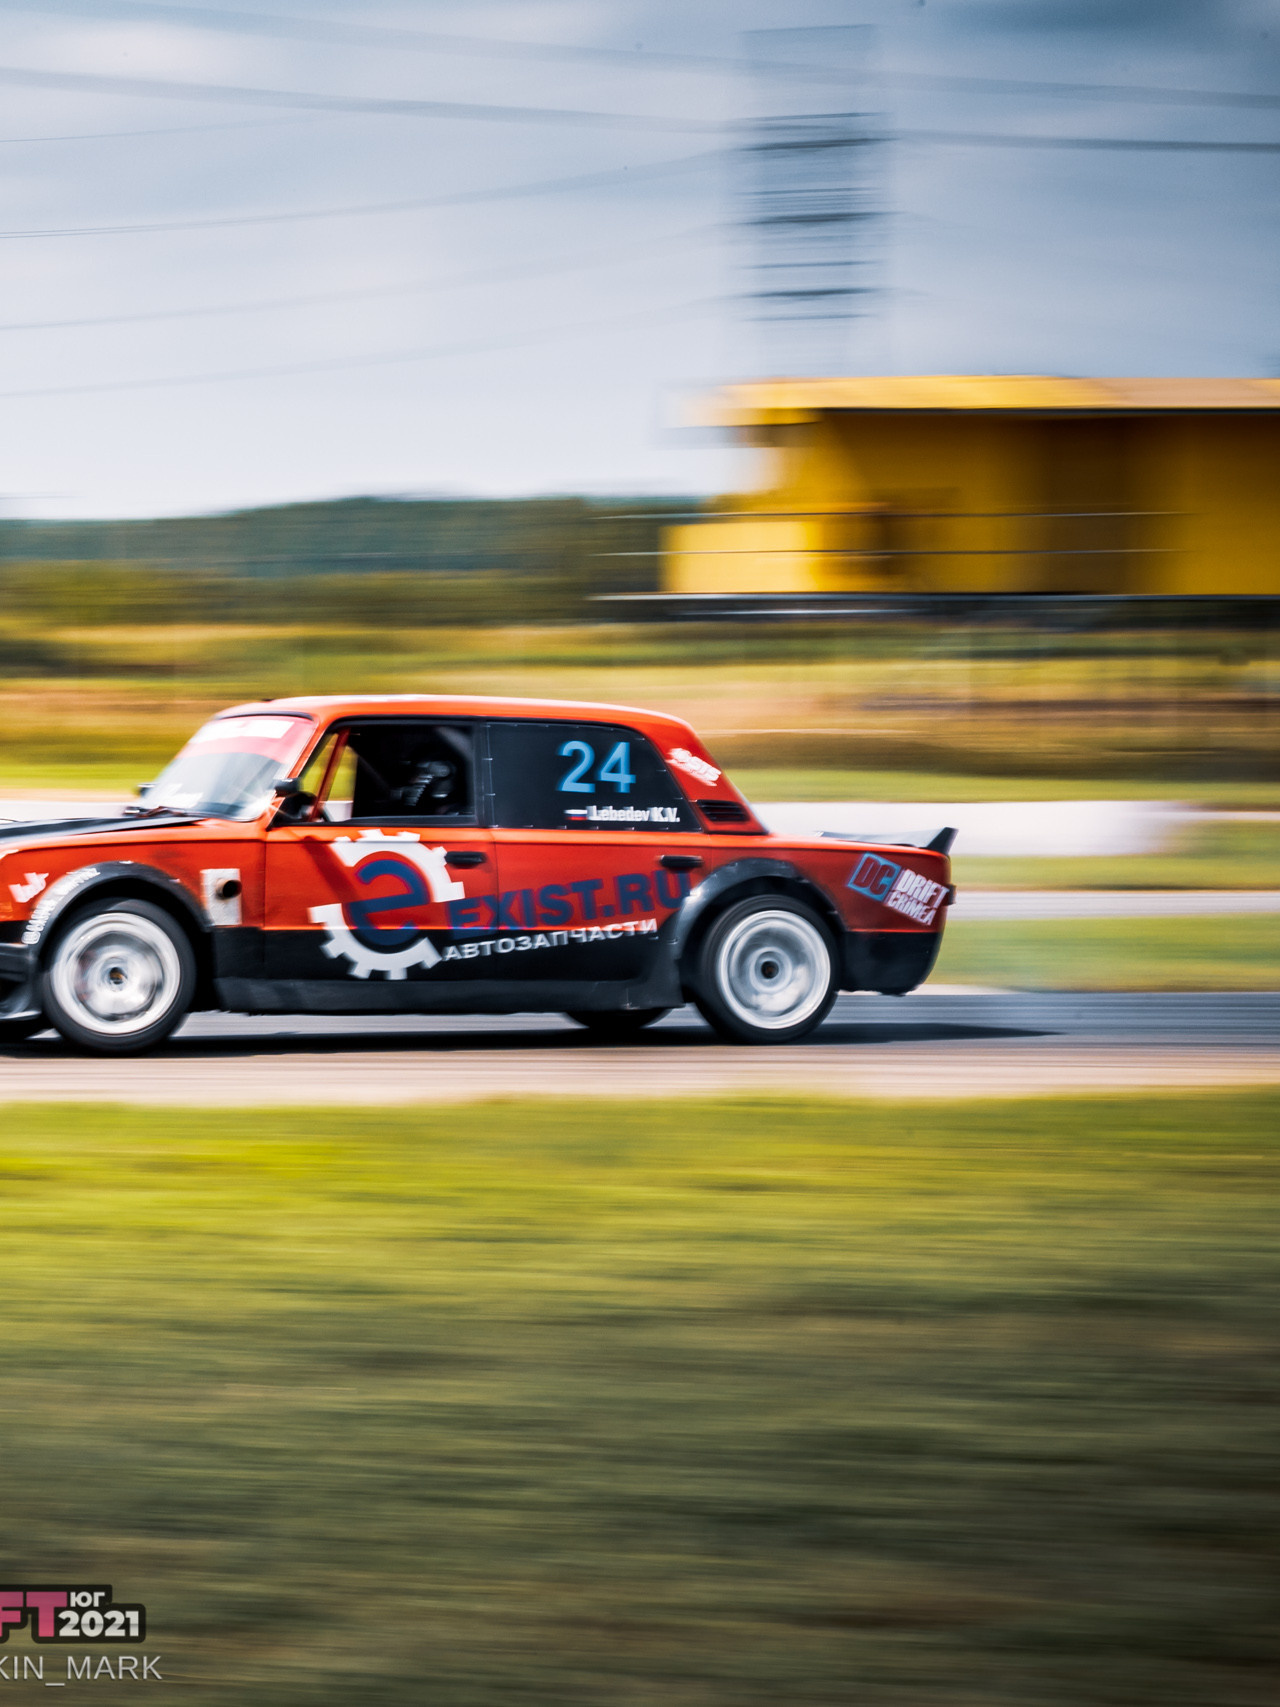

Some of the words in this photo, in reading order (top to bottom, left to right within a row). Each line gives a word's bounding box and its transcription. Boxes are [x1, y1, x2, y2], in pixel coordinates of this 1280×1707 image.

[556, 740, 637, 793] 24
[586, 805, 650, 821] Lebedev
[648, 806, 680, 822] K.V.
[851, 856, 896, 897] DC
[443, 868, 693, 941] EXIST.RU
[442, 918, 658, 962] АВТОЗАПЧАСТИ
